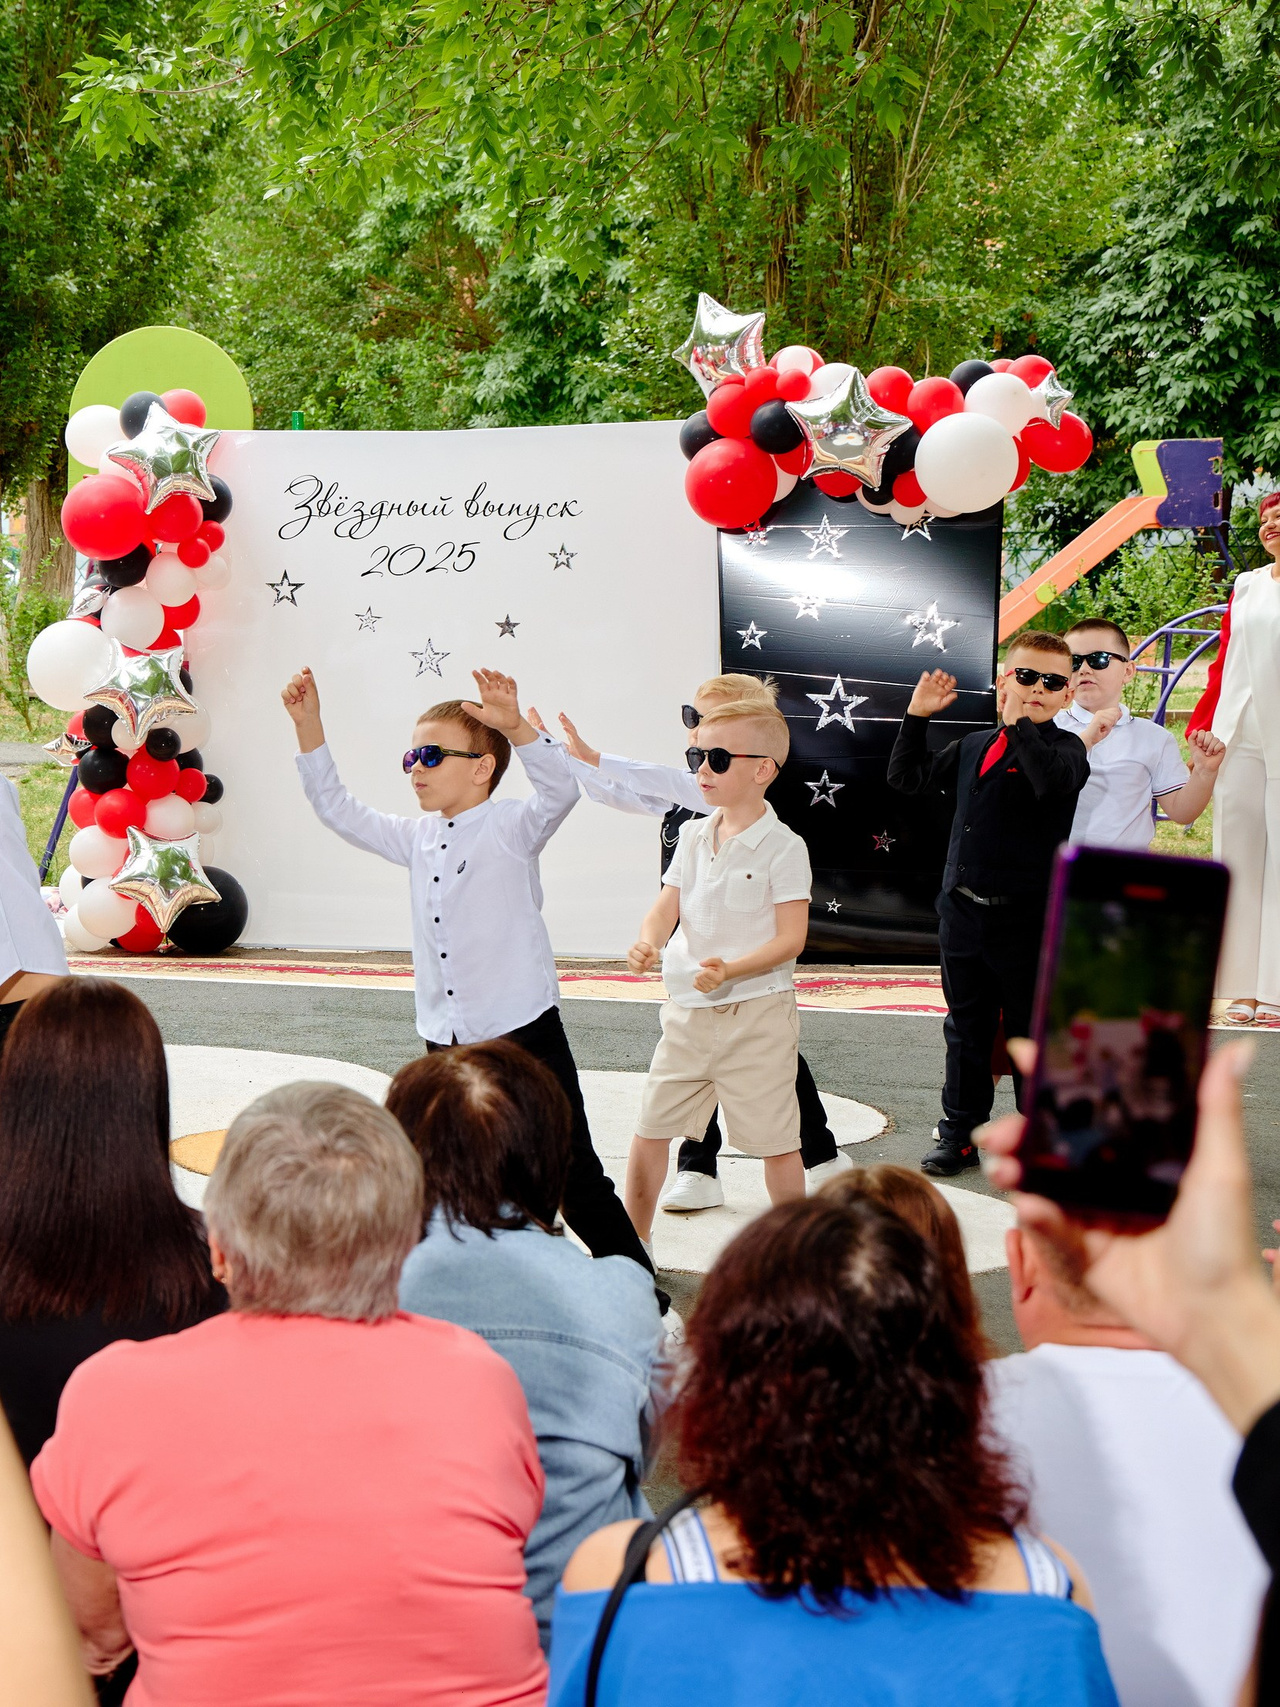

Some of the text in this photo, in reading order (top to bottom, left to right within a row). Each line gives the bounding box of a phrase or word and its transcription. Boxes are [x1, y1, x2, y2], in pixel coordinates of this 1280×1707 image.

[277, 474, 583, 541] Звёздный выпуск
[361, 541, 481, 578] 2025
